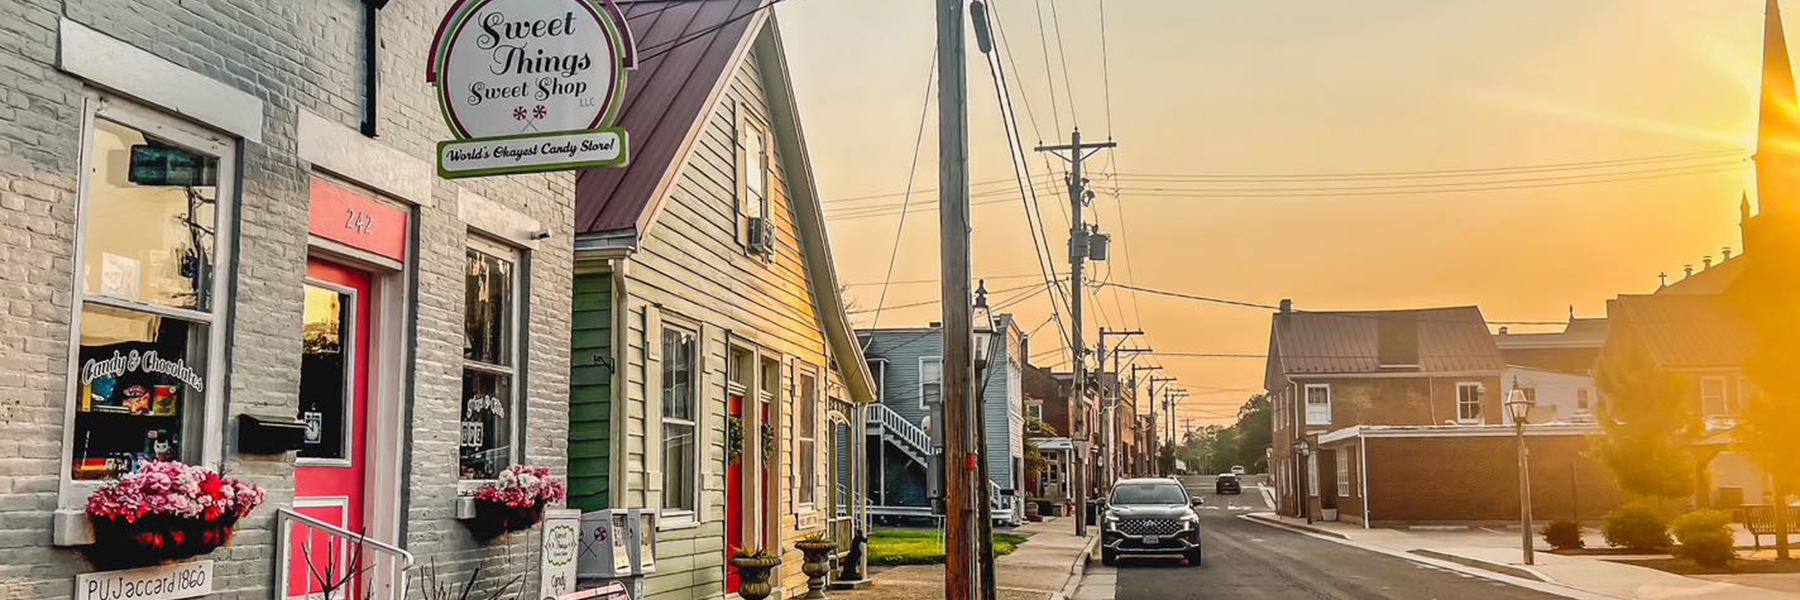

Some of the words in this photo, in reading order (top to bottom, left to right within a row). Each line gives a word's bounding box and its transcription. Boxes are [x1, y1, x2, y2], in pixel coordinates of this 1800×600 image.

[476, 12, 577, 50] Sweet
[489, 41, 591, 78] Things
[467, 81, 530, 106] Sweet
[534, 77, 587, 102] Shop
[579, 96, 595, 107] LLC
[446, 146, 490, 162] World's
[493, 145, 538, 161] Okayest
[541, 141, 577, 158] Candy
[580, 138, 615, 152] Store!
[344, 208, 373, 235] 242
[82, 350, 127, 386] Candy
[127, 349, 142, 372] &
[142, 351, 204, 393] Chocolates
[177, 569, 206, 591] 1860
